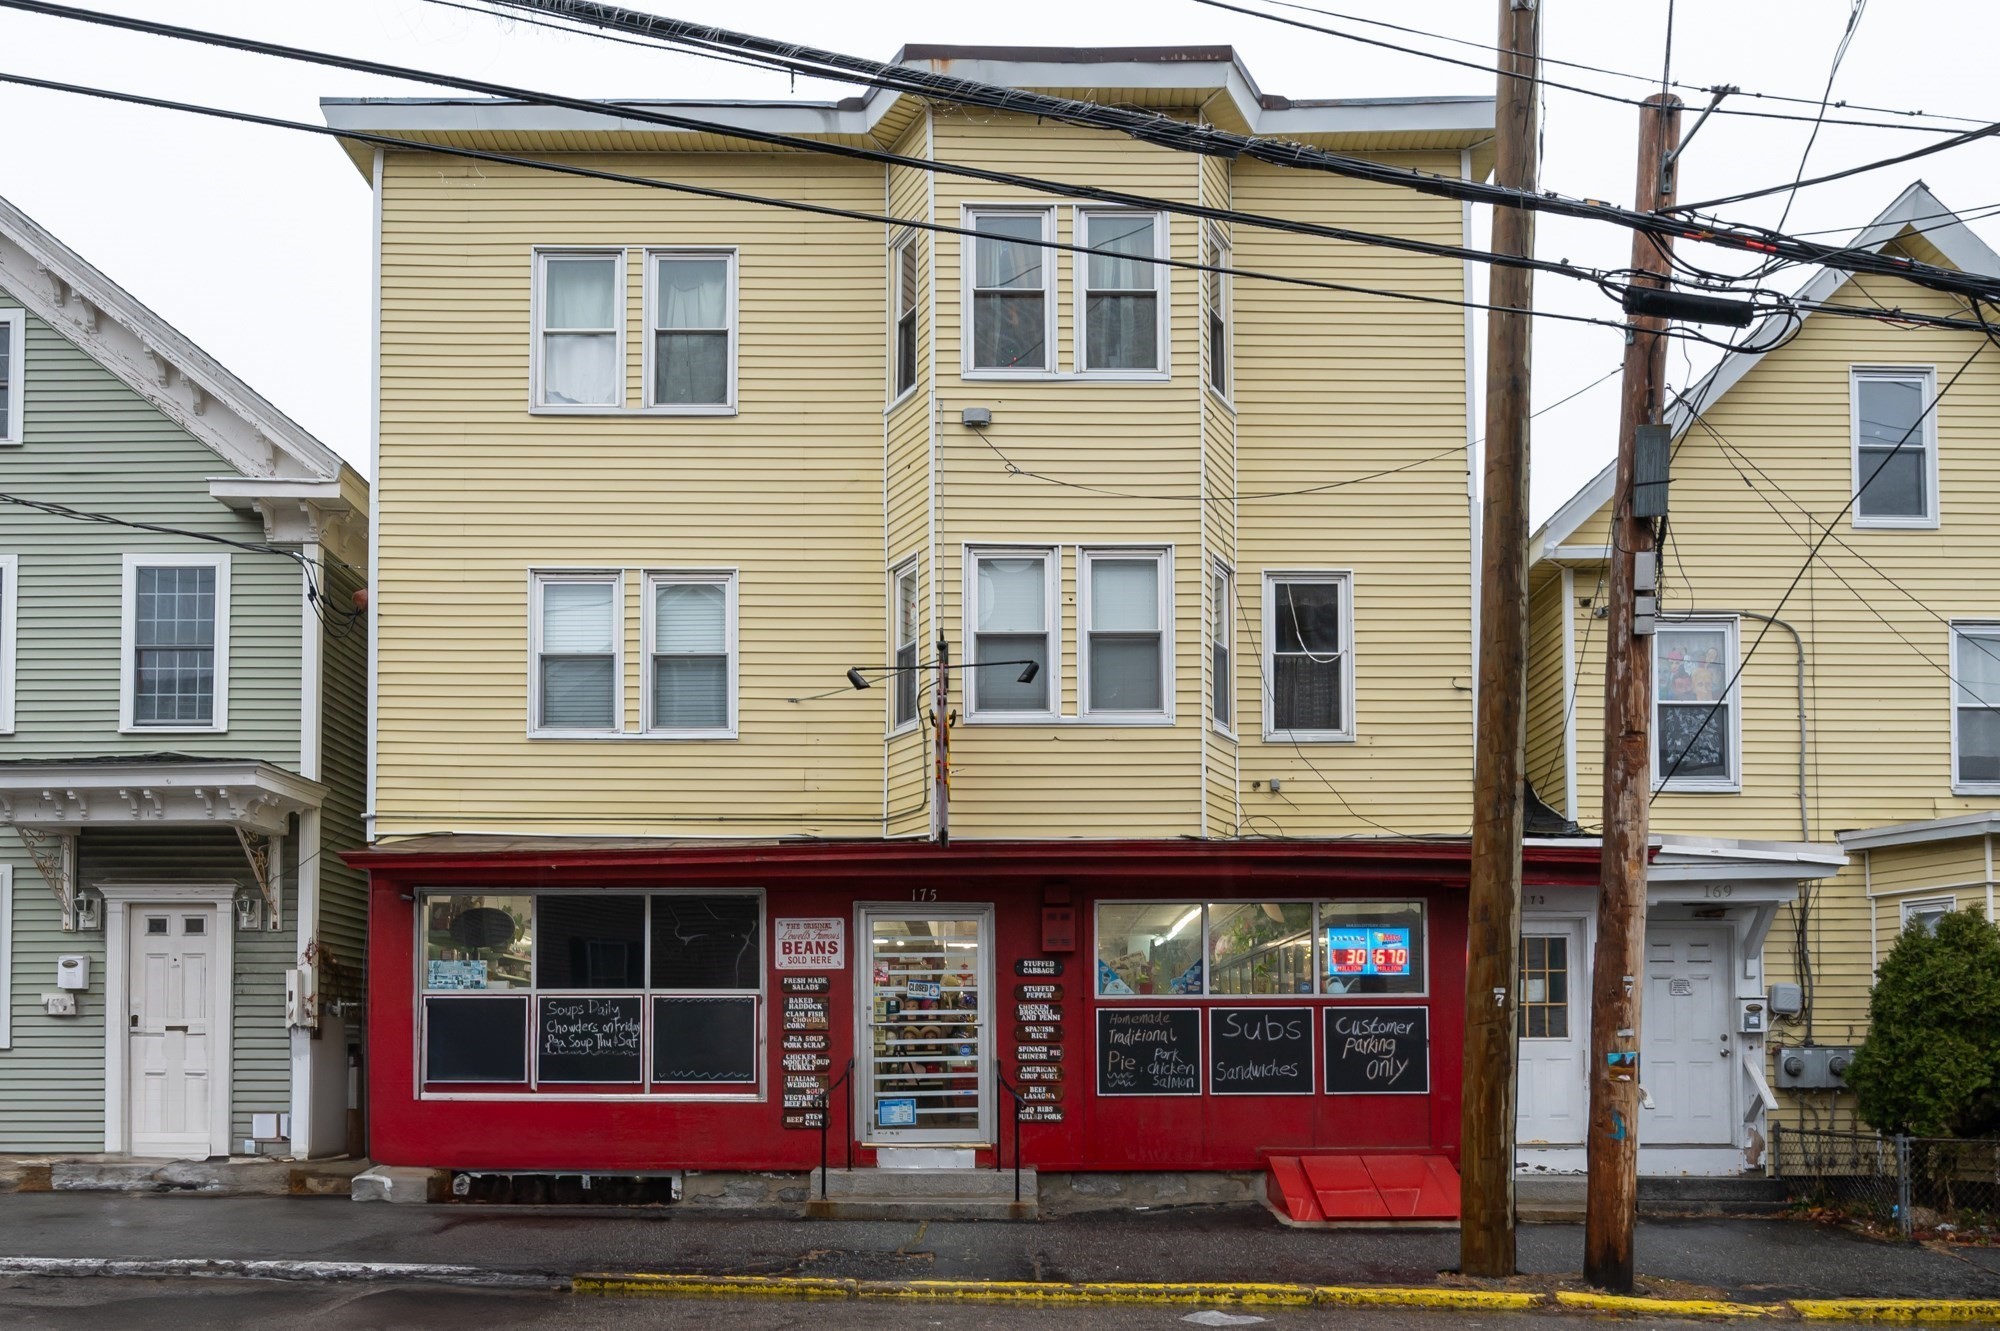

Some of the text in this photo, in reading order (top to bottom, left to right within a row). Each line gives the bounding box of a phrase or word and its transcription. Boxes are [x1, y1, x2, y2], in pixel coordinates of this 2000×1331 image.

[912, 888, 937, 902] 175
[1703, 884, 1732, 898] 169
[1523, 895, 1545, 905] 173
[811, 930, 840, 940] Famous
[782, 940, 838, 955] BEANS
[788, 956, 832, 964] SOLD HERE
[1346, 949, 1366, 965] 30
[1376, 949, 1406, 965] 670
[908, 982, 928, 992] CLOSED
[1625, 985, 1633, 998] 7
[546, 1000, 621, 1020] Soups Daily
[546, 1019, 598, 1034] Chowders
[602, 1022, 614, 1033] on
[1109, 1012, 1171, 1026] Homemade
[1336, 1016, 1414, 1035] Customer
[1222, 1013, 1302, 1041] Subs
[568, 1034, 593, 1053] Soup
[595, 1033, 612, 1049] Thu
[618, 1032, 638, 1048] Sat
[1109, 1028, 1178, 1046] Traditional
[1108, 1050, 1136, 1072] Pie
[1154, 1048, 1184, 1063] Pork
[1216, 1058, 1298, 1081] Sandwiches
